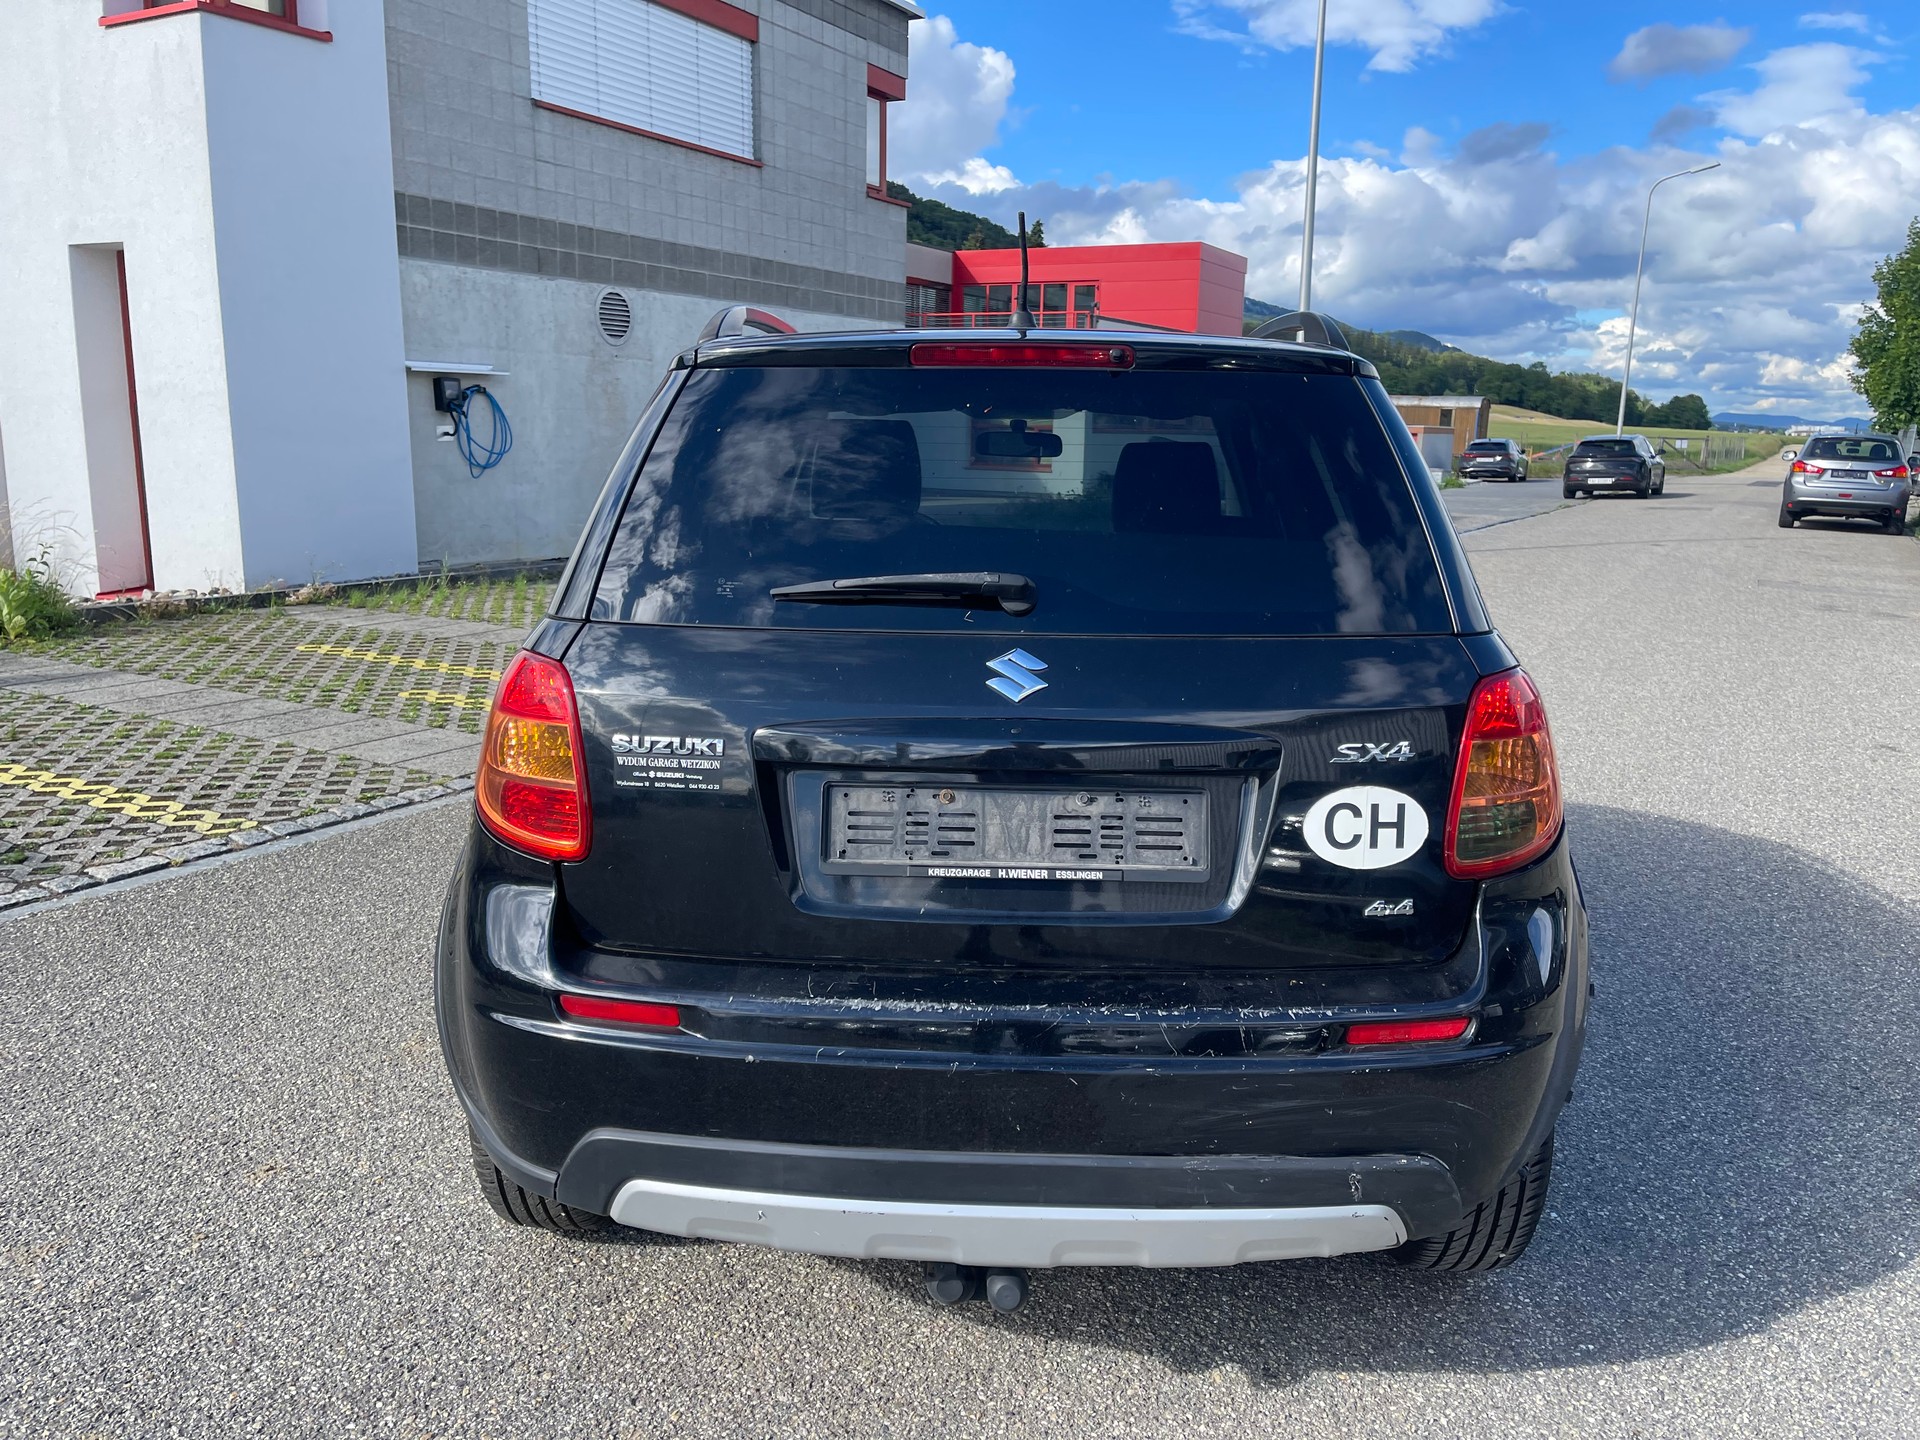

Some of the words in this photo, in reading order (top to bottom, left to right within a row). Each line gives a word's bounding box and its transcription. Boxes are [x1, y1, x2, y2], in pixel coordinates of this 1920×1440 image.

[611, 733, 725, 756] SUZUKI
[1329, 740, 1416, 763] SX4
[616, 756, 647, 767] WYDUM
[648, 758, 679, 769] GARAGE
[680, 759, 720, 770] WETZIKON
[656, 771, 684, 779] SUZUKI
[1324, 802, 1406, 850] CH
[928, 867, 991, 878] KREUZGARAGE
[998, 868, 1049, 879] H.WIENER
[1055, 870, 1103, 880] ESSLINGEN
